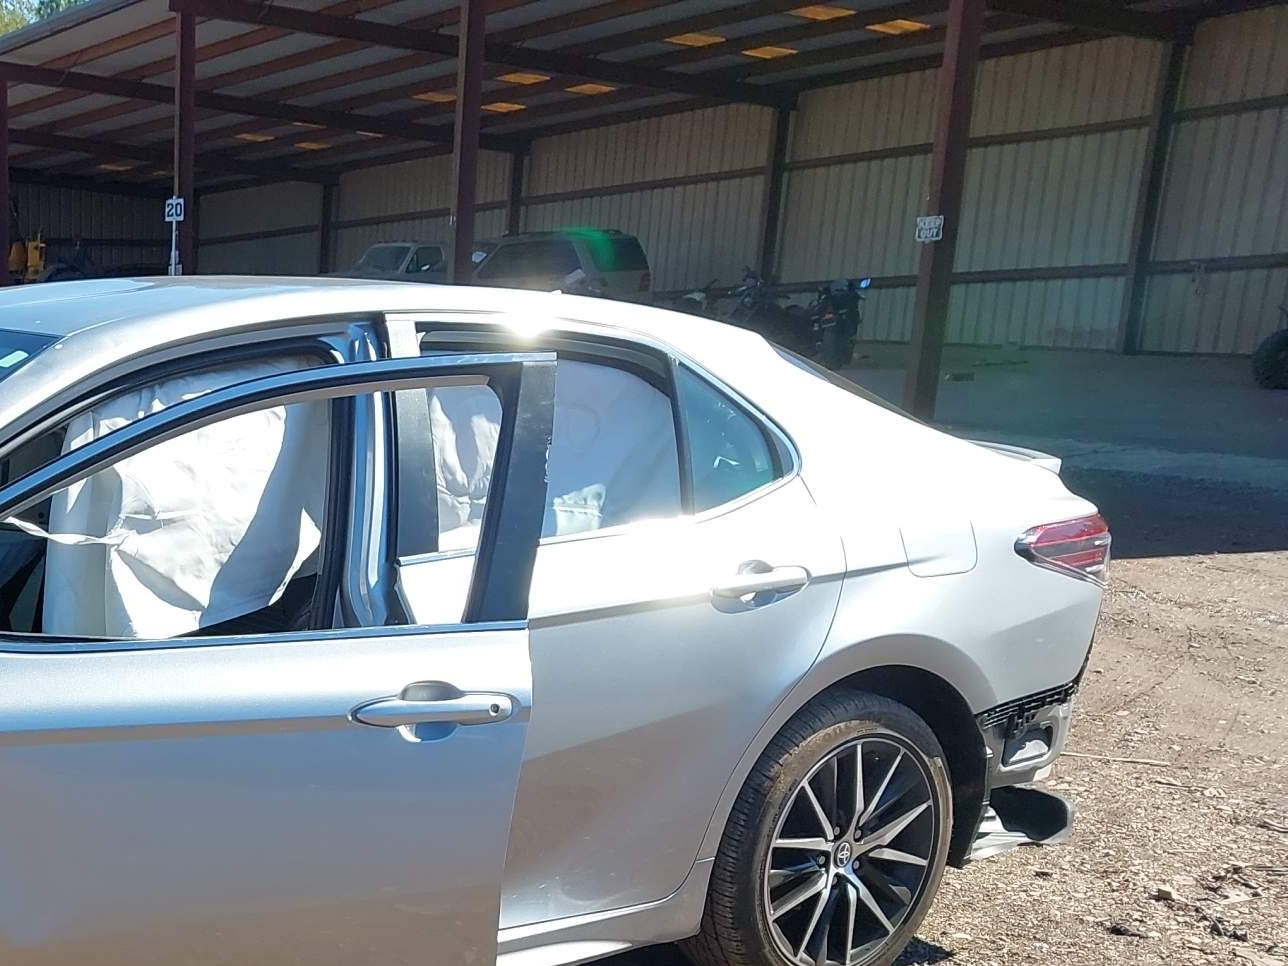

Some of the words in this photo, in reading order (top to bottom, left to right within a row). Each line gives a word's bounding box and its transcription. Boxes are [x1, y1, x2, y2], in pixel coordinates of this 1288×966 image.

[166, 202, 182, 218] 20
[919, 219, 942, 229] KEEP
[920, 228, 938, 238] OUT
